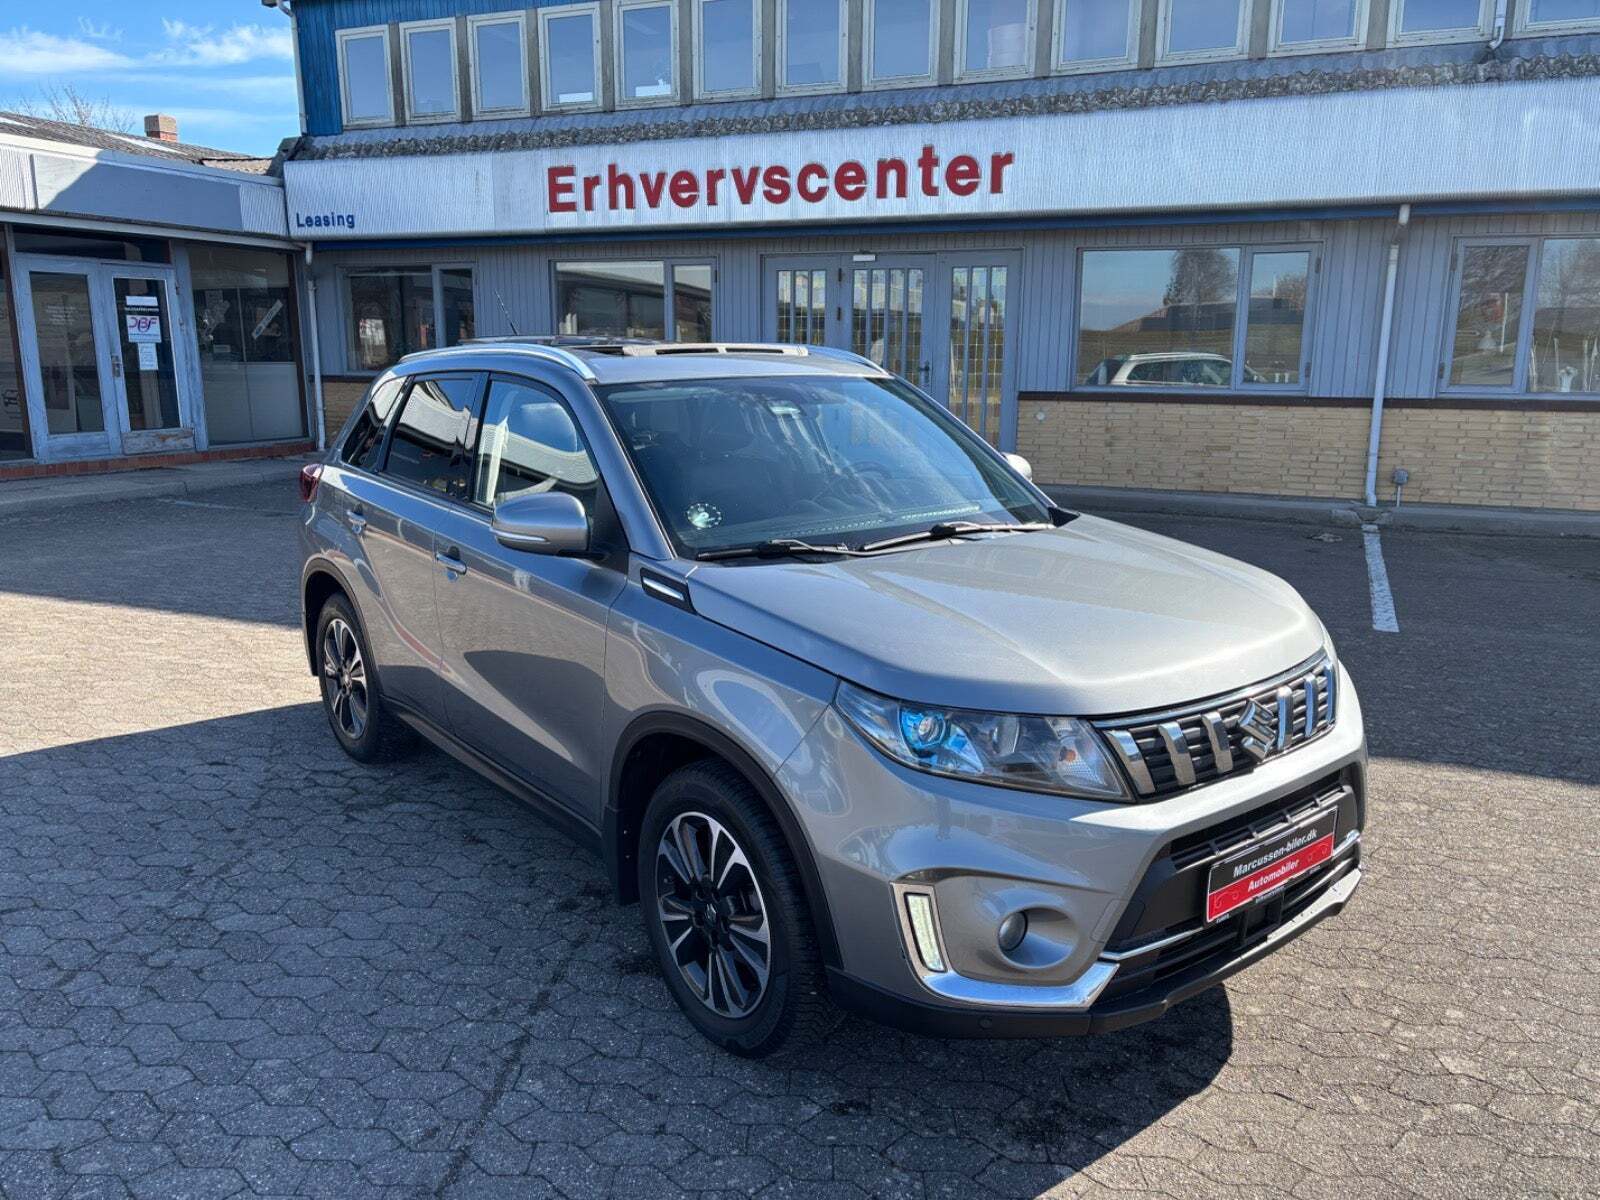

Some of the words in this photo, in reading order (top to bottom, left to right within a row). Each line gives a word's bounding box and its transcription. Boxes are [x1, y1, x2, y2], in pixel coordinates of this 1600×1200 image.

[547, 144, 1015, 213] Erhvervscenter
[296, 212, 355, 229] Leasing
[1233, 828, 1318, 878] Marcussen-biler.dk
[1247, 859, 1300, 892] Automobiler
